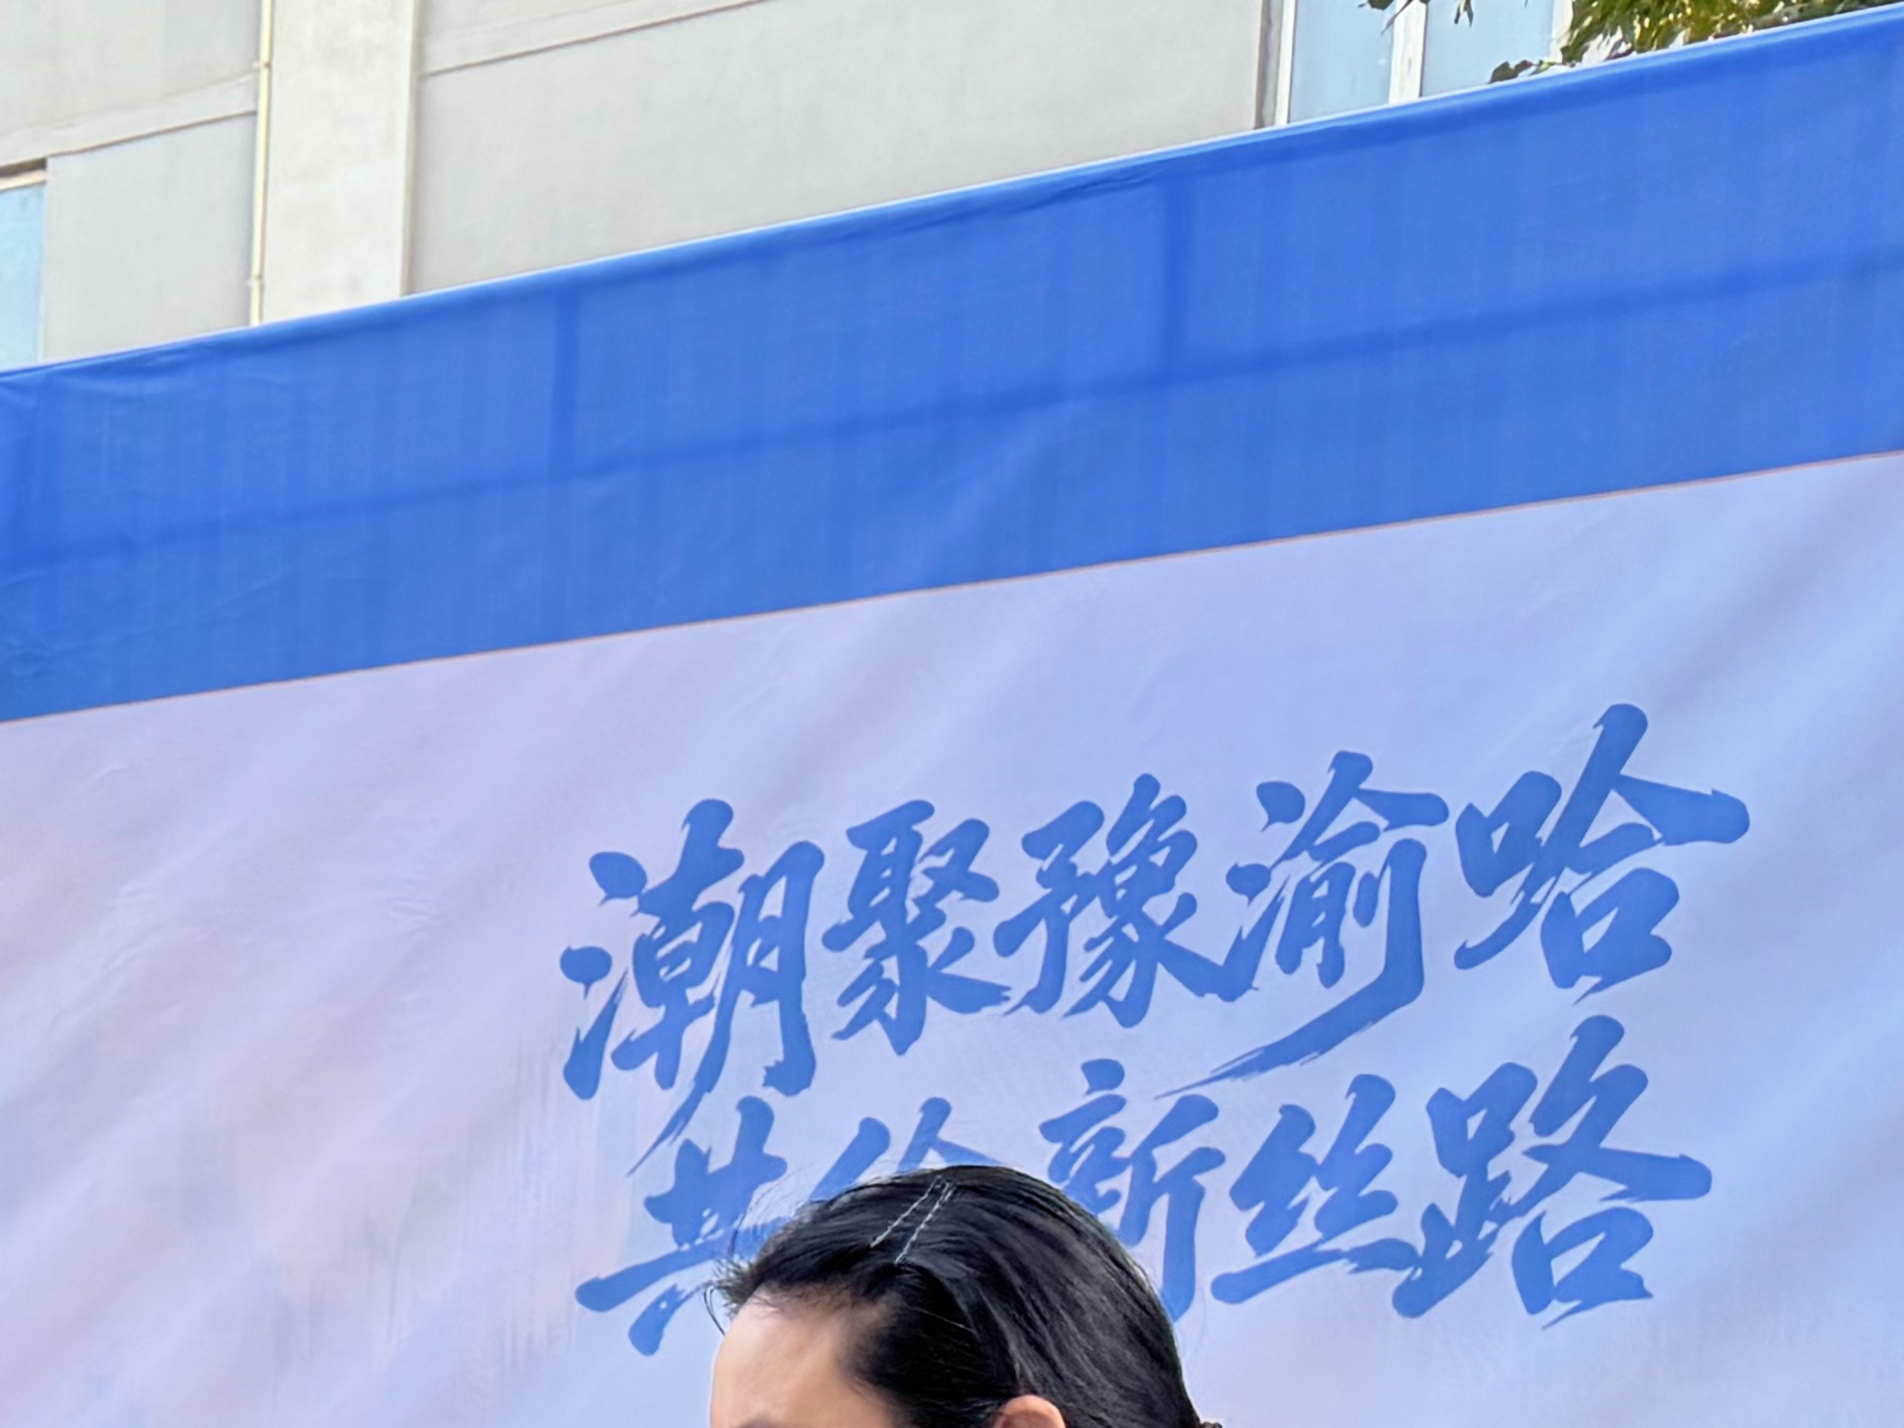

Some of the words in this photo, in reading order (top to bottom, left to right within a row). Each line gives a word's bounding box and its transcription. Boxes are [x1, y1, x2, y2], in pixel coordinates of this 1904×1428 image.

[560, 703, 1750, 1160] 潮聚豫渝哈
